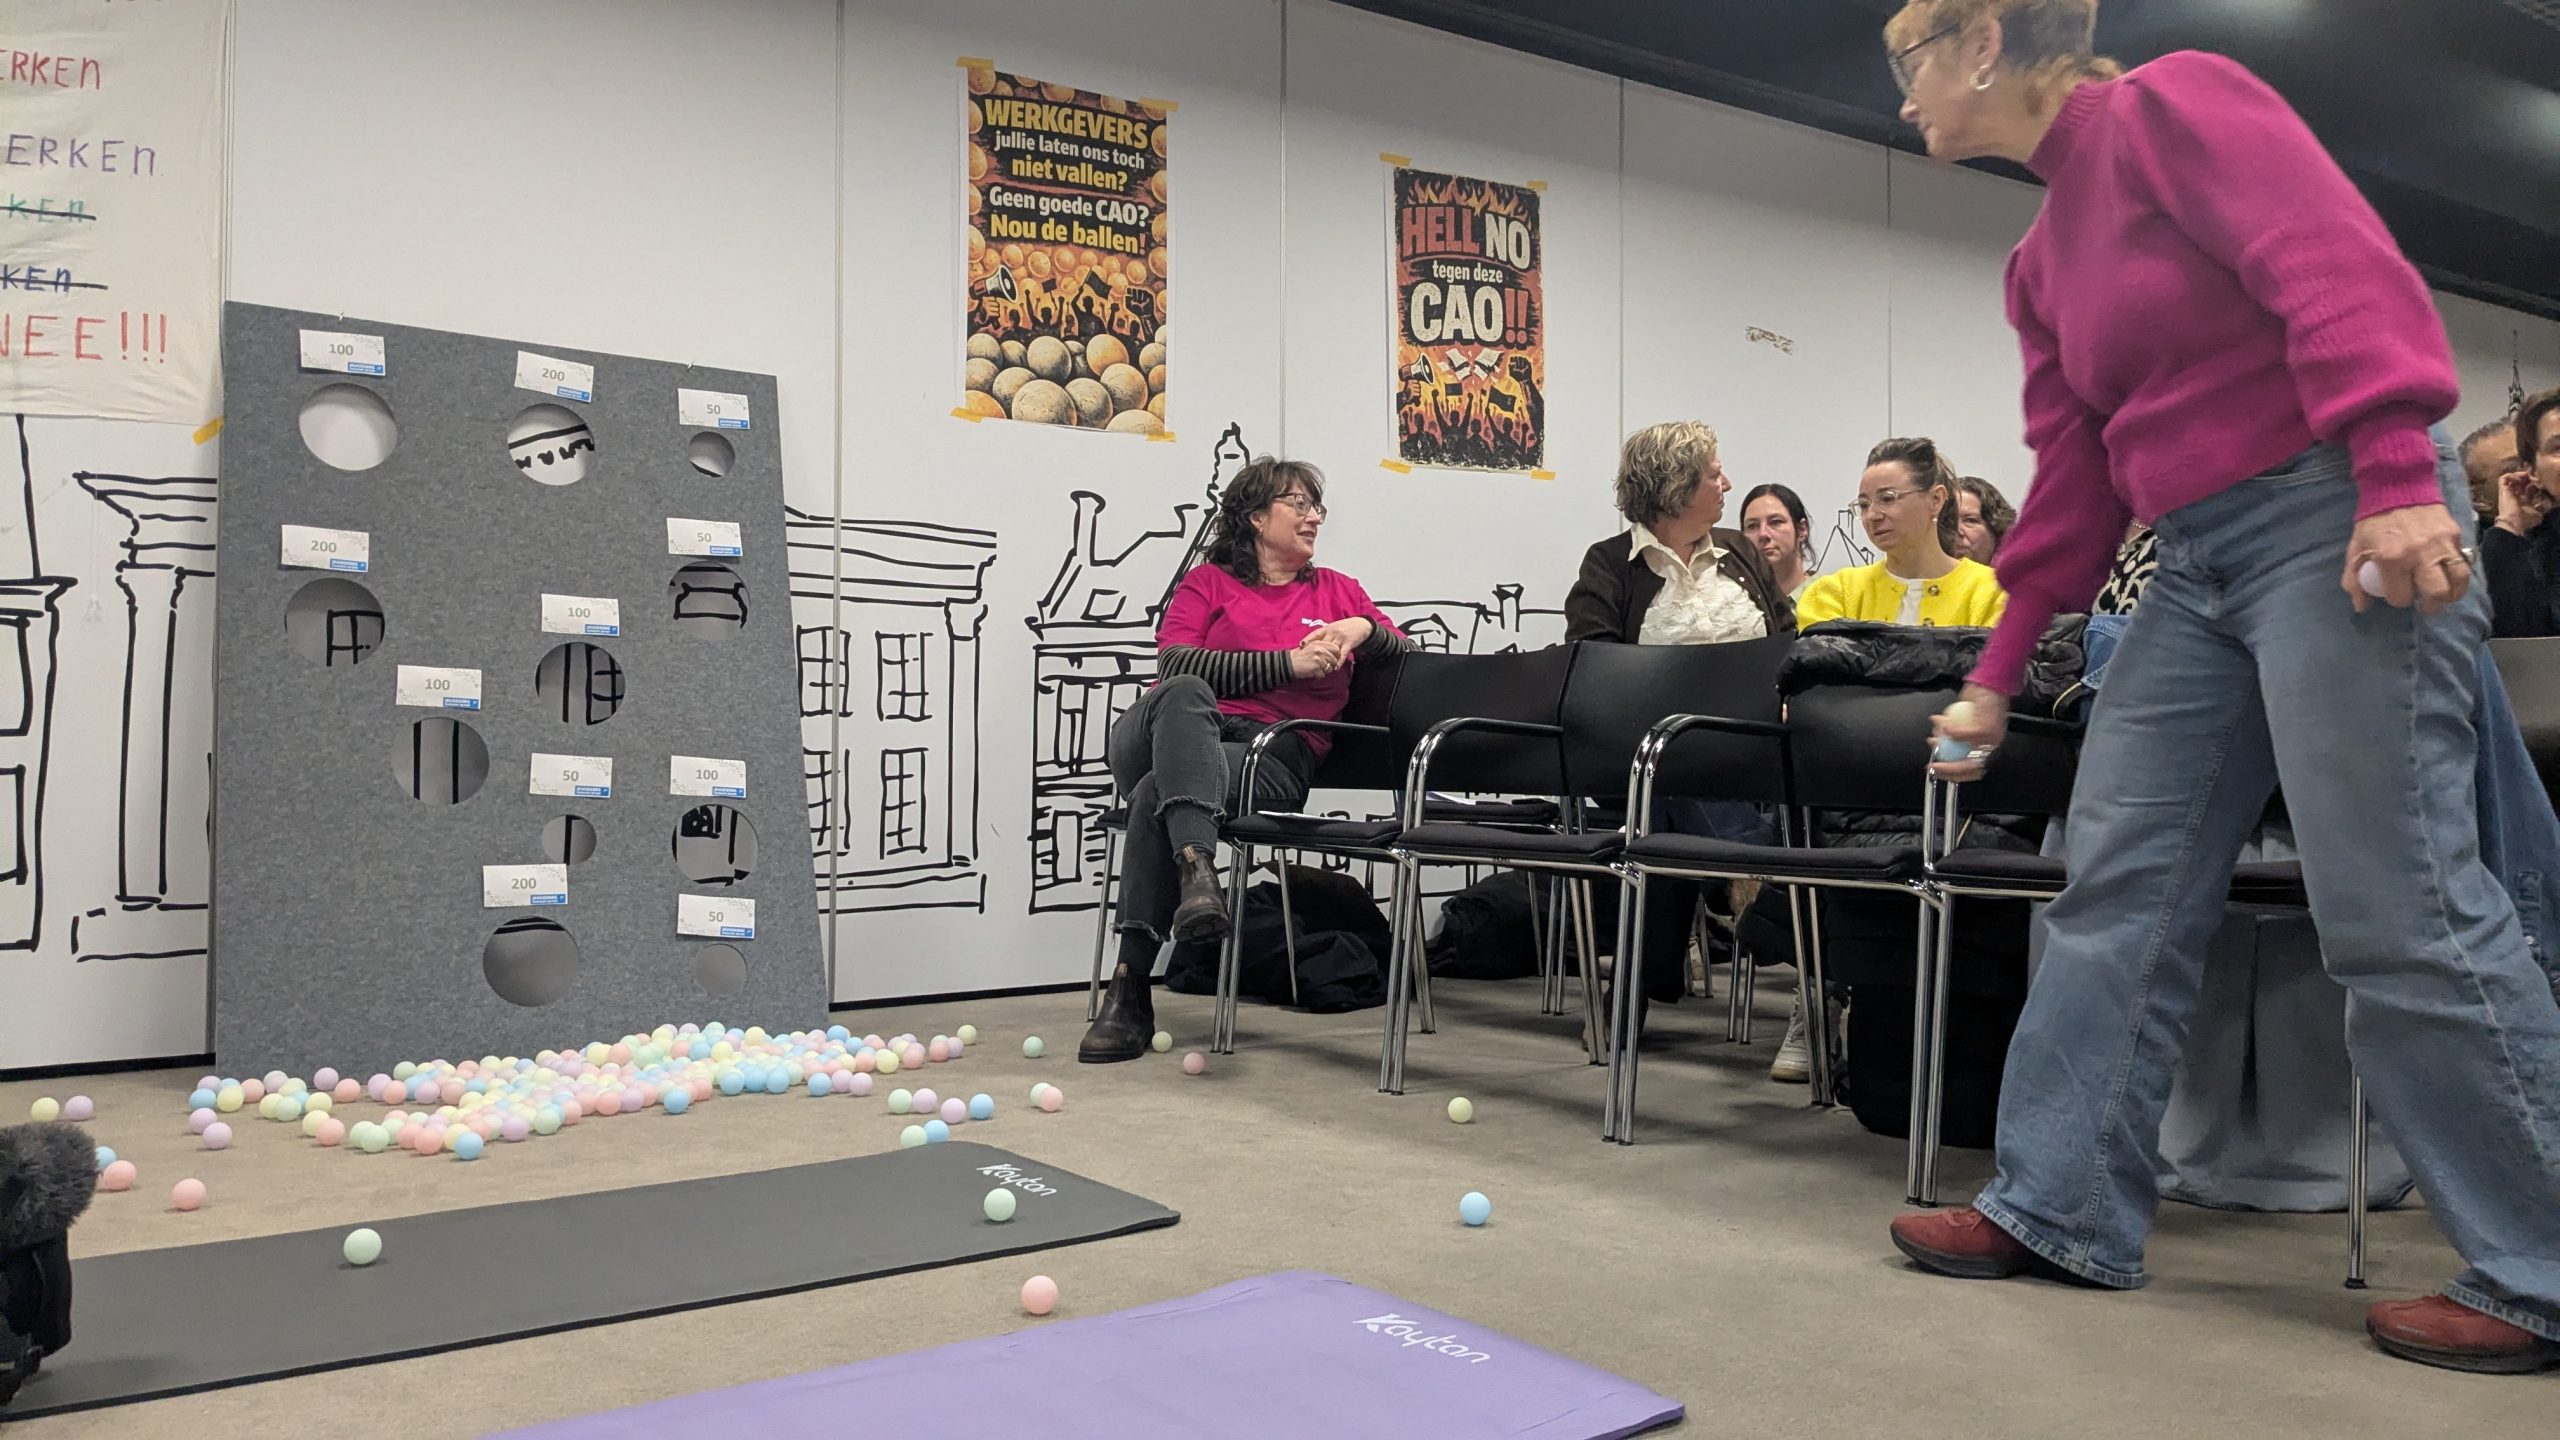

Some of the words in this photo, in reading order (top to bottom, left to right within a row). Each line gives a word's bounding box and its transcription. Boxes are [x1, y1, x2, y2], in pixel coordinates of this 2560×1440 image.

[985, 98, 1148, 149] WERKGEVERS
[994, 130, 1036, 152] jullie
[1039, 134, 1079, 157] laten
[1082, 145, 1109, 163] ons
[1112, 149, 1145, 170] toch
[1012, 154, 1054, 179] niet
[1055, 162, 1128, 192] vallen?
[989, 186, 1036, 210] Geen
[1039, 196, 1093, 217] goede
[1095, 199, 1150, 228] CAO?
[990, 213, 1037, 239] Nou
[1041, 217, 1068, 242] de
[1073, 221, 1147, 256] ballen!
[1401, 206, 1480, 258] HELL
[1485, 212, 1531, 271] NO
[1432, 259, 1470, 284] tegen
[1474, 261, 1503, 284] deze
[1410, 281, 1529, 345] CAO!!
[329, 344, 354, 357] 100
[541, 368, 566, 382] 200
[706, 404, 721, 415] 50
[696, 532, 712, 544] 50
[310, 540, 338, 554] 200
[567, 607, 592, 619] 100
[424, 678, 451, 692] 100
[562, 769, 580, 782] 50
[695, 768, 719, 781] 100
[511, 877, 537, 890] 200
[708, 910, 724, 923] 50
